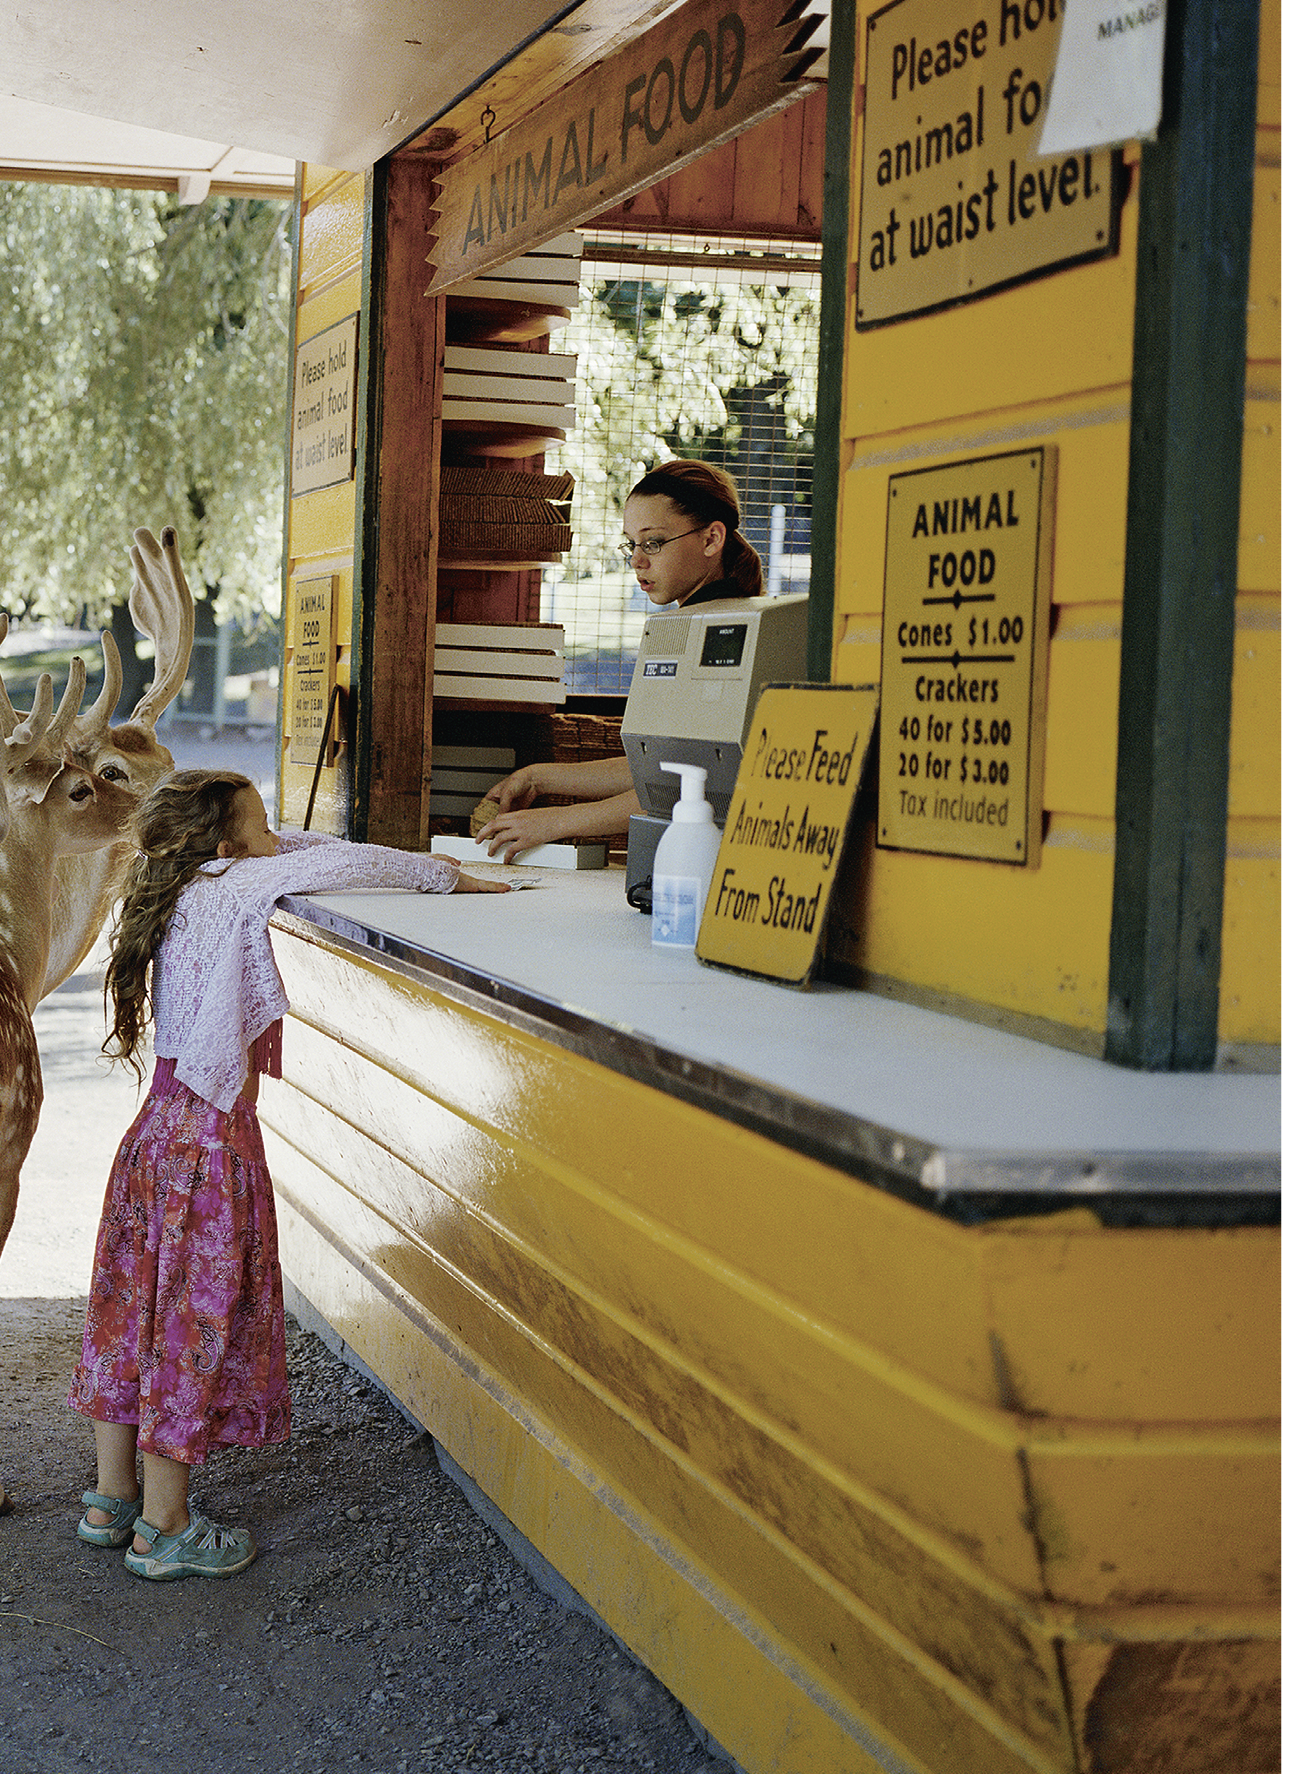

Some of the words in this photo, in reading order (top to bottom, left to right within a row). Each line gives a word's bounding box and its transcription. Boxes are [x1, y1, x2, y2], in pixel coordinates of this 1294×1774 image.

[892, 20, 987, 99] Please
[461, 108, 607, 256] ANIMAL
[621, 12, 746, 164] FOOD
[877, 85, 984, 187] animal
[1003, 67, 1055, 134] fo
[870, 209, 900, 272] at
[910, 169, 999, 259] waist
[1008, 150, 1101, 227] level.
[302, 360, 325, 388] Please
[328, 340, 347, 375] hold
[298, 391, 324, 430] animal
[328, 379, 349, 417] food
[912, 490, 1019, 538] ANIMAL
[928, 548, 996, 588] FOOD
[300, 594, 325, 614] ANIMAL
[303, 621, 320, 638] FOOD
[898, 621, 952, 648] Cones
[968, 615, 1023, 650] $1.00
[916, 672, 999, 702] Crackers
[899, 716, 920, 741] 40
[927, 714, 952, 742] for
[751, 727, 806, 782] Please
[805, 730, 859, 787] Feed
[899, 752, 919, 777] 20
[926, 751, 951, 780] for
[900, 790, 927, 817] Tax
[933, 790, 1009, 827] included
[730, 799, 794, 850] Animals
[793, 805, 840, 871] Away
[715, 868, 760, 923] From
[762, 876, 822, 935] Stand
